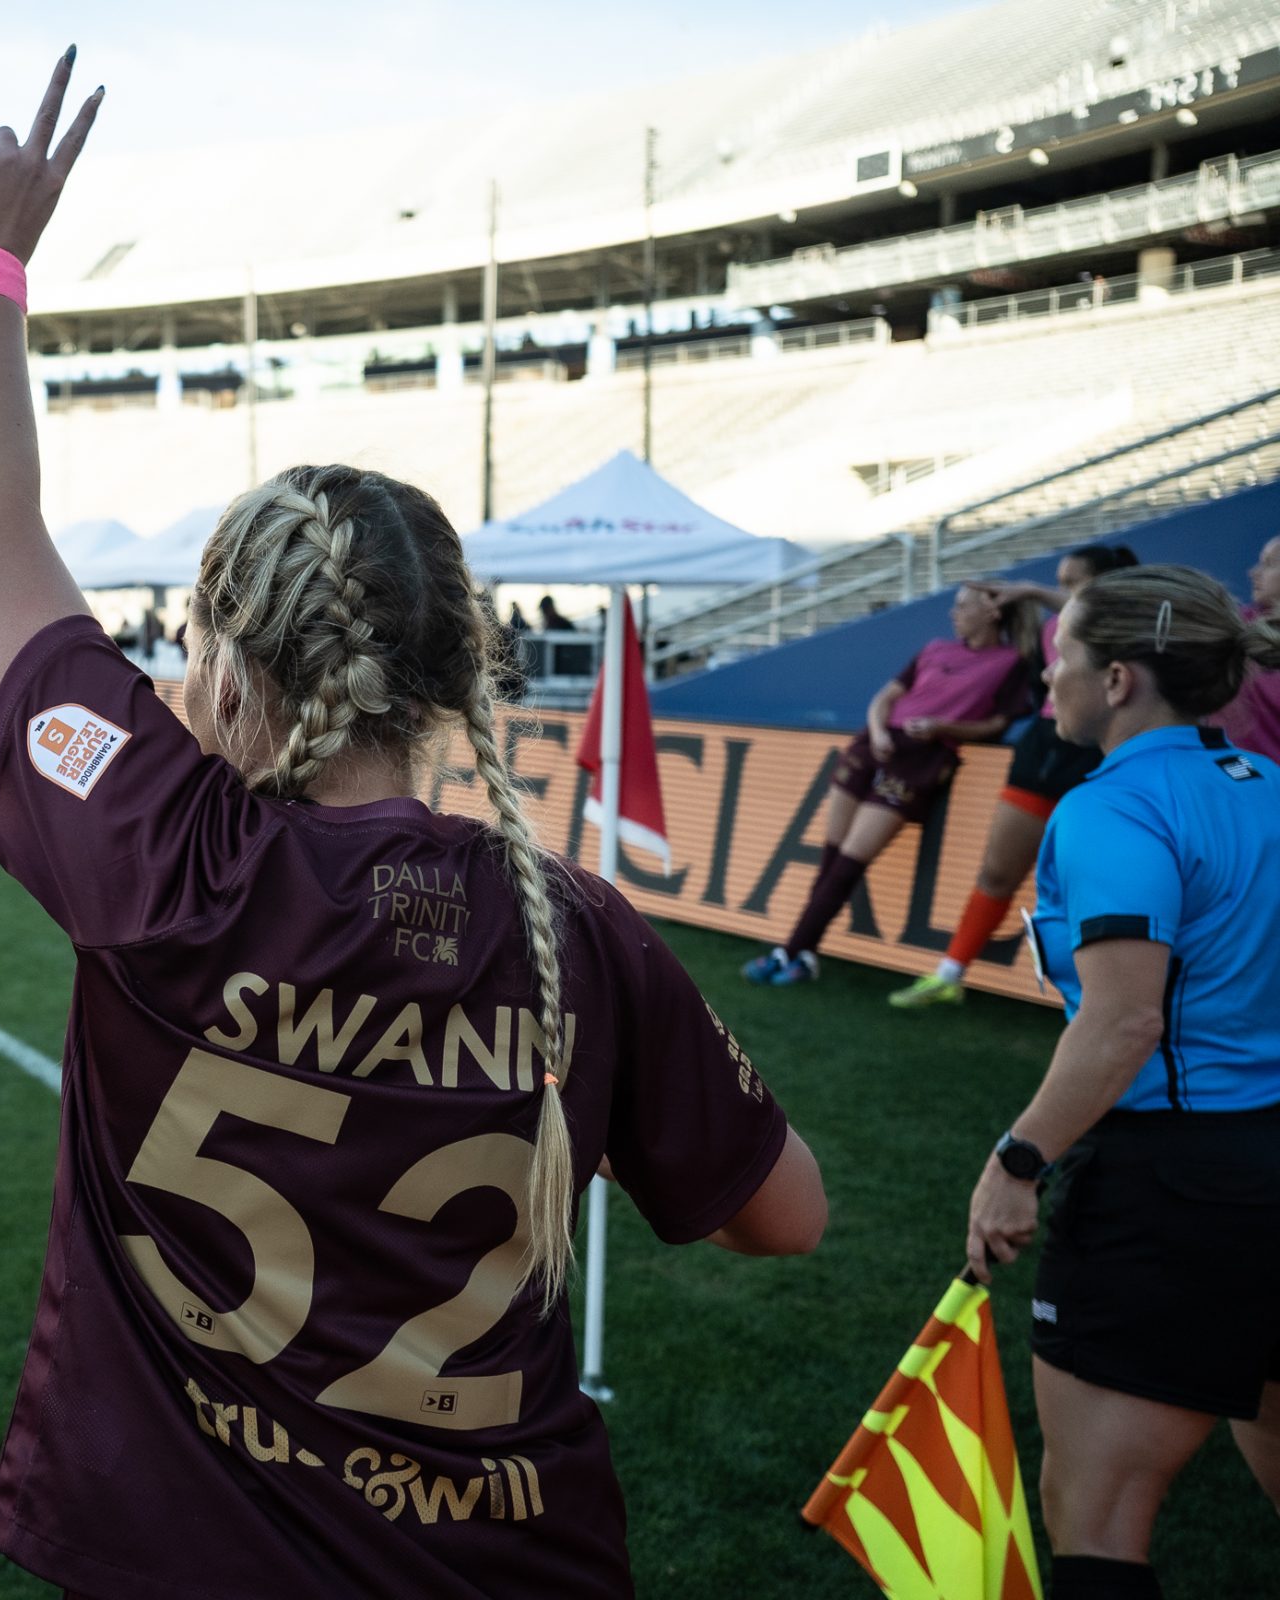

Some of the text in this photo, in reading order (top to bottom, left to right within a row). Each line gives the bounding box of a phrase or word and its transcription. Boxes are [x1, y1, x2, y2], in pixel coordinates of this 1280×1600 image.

[47, 728, 65, 745] S
[56, 720, 97, 776] LEAGUE
[67, 727, 108, 781] SUPER
[78, 742, 112, 787] GAINBRIDGE
[372, 861, 468, 902] DALLA
[393, 927, 430, 962] FC
[204, 971, 577, 1092] SWANN
[118, 1047, 532, 1431] 52
